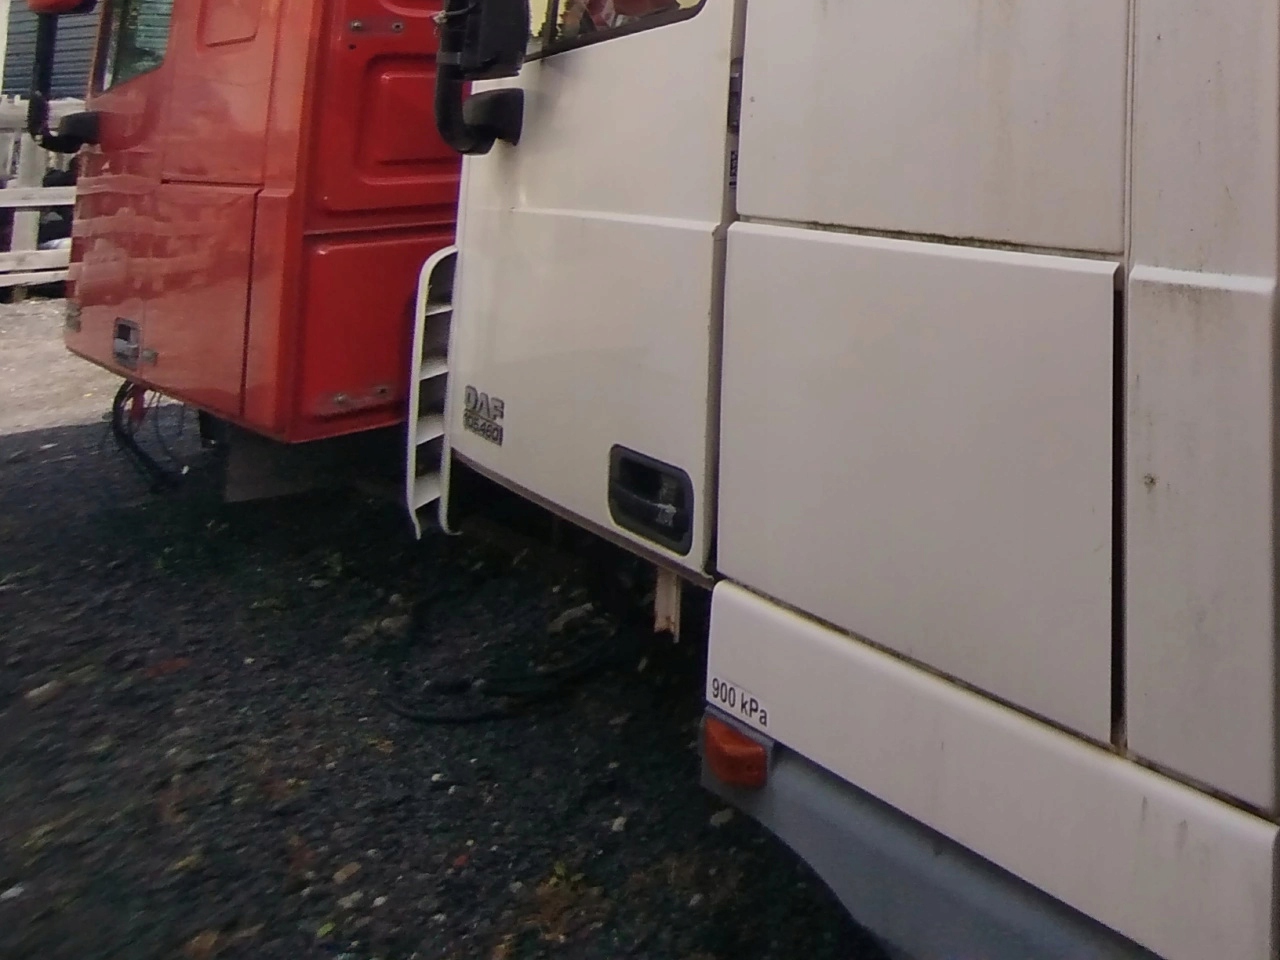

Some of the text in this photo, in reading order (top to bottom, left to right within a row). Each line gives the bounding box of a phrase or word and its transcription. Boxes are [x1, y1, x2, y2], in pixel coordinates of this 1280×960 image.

[464, 385, 504, 421] DAF
[712, 678, 768, 727] 900 kPa
